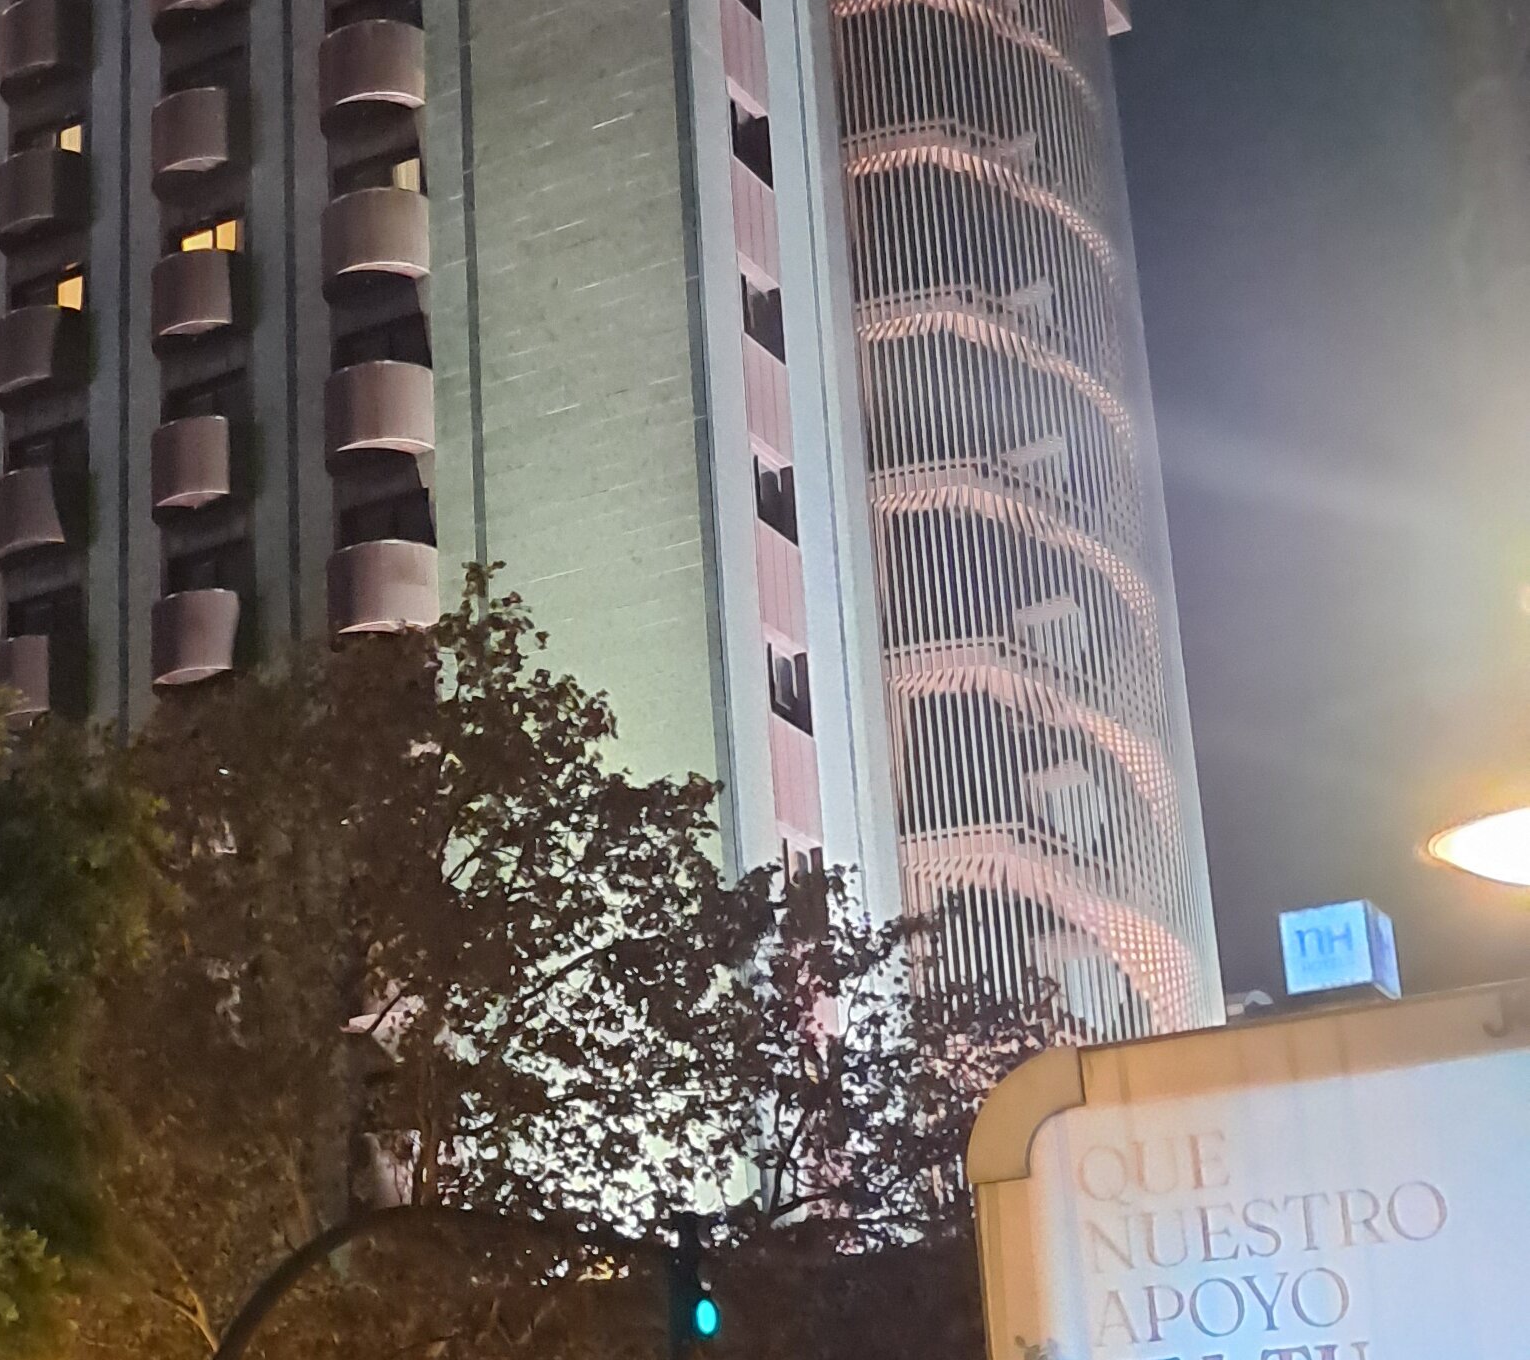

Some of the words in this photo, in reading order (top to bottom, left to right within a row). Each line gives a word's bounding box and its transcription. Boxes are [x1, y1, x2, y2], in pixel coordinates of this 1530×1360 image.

[1077, 1129, 1231, 1206] QUE
[1084, 1179, 1448, 1274] NUESTRO
[1094, 1266, 1350, 1348] APOYO
